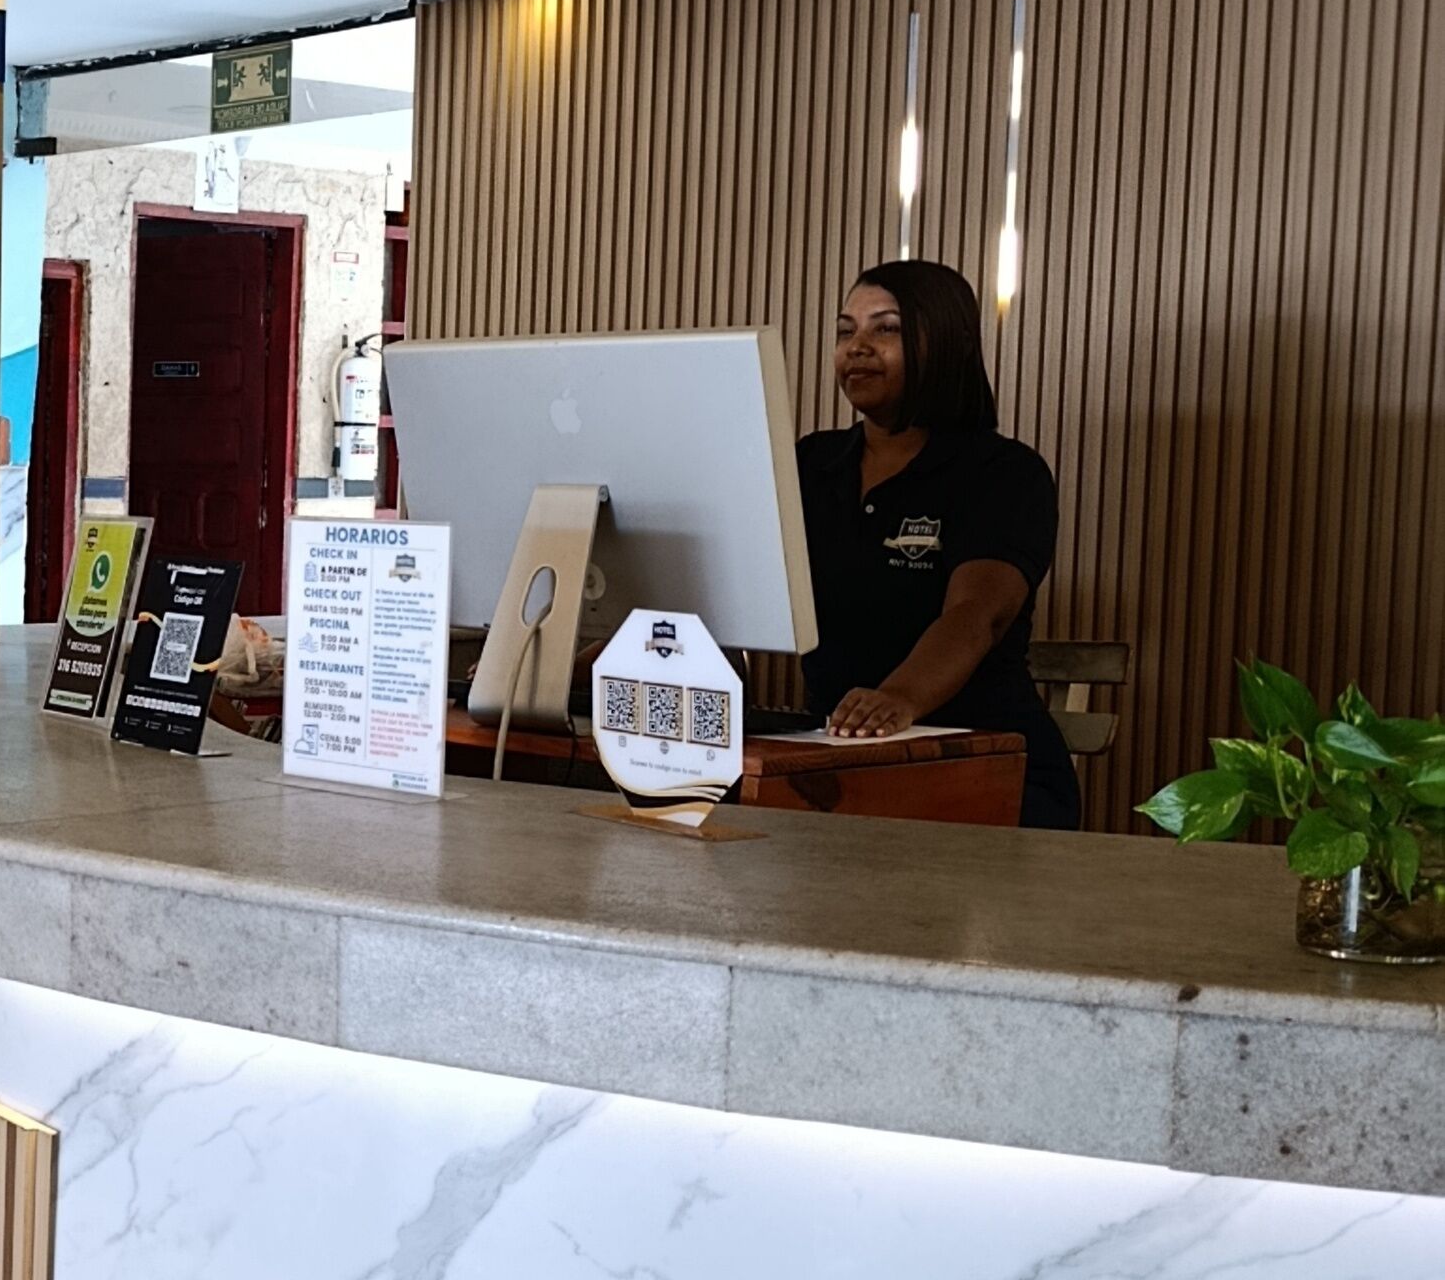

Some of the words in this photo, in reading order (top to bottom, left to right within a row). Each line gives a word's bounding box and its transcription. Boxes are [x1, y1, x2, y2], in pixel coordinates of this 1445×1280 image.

[908, 524, 932, 534] HOTEL
[326, 526, 408, 546] HORARIOS
[310, 547, 344, 560] CHECK
[346, 550, 358, 560] IN
[328, 566, 355, 575] PARTIR
[357, 568, 367, 576] DE
[304, 588, 338, 599] CHECK
[341, 590, 362, 601] OUT
[303, 604, 328, 612] HASTA
[330, 606, 349, 615] 12:00
[351, 607, 362, 616] PM
[310, 617, 349, 630] PISCINA
[654, 626, 674, 634] HOTEL
[340, 636, 351, 644] AM
[321, 643, 337, 651] 7:00
[338, 644, 350, 652] PM
[299, 660, 364, 676] RESTAURANTE
[304, 678, 346, 689] DESAYUNO:
[304, 687, 320, 695] 7:00
[328, 689, 348, 698] 10:00
[304, 702, 344, 712] ALMUERZO:
[331, 713, 346, 721] 2:00
[349, 715, 360, 723] PM
[320, 734, 341, 743] CENA:
[345, 737, 361, 746] 5:00
[326, 743, 342, 752] 7:00
[344, 745, 356, 753] PM
